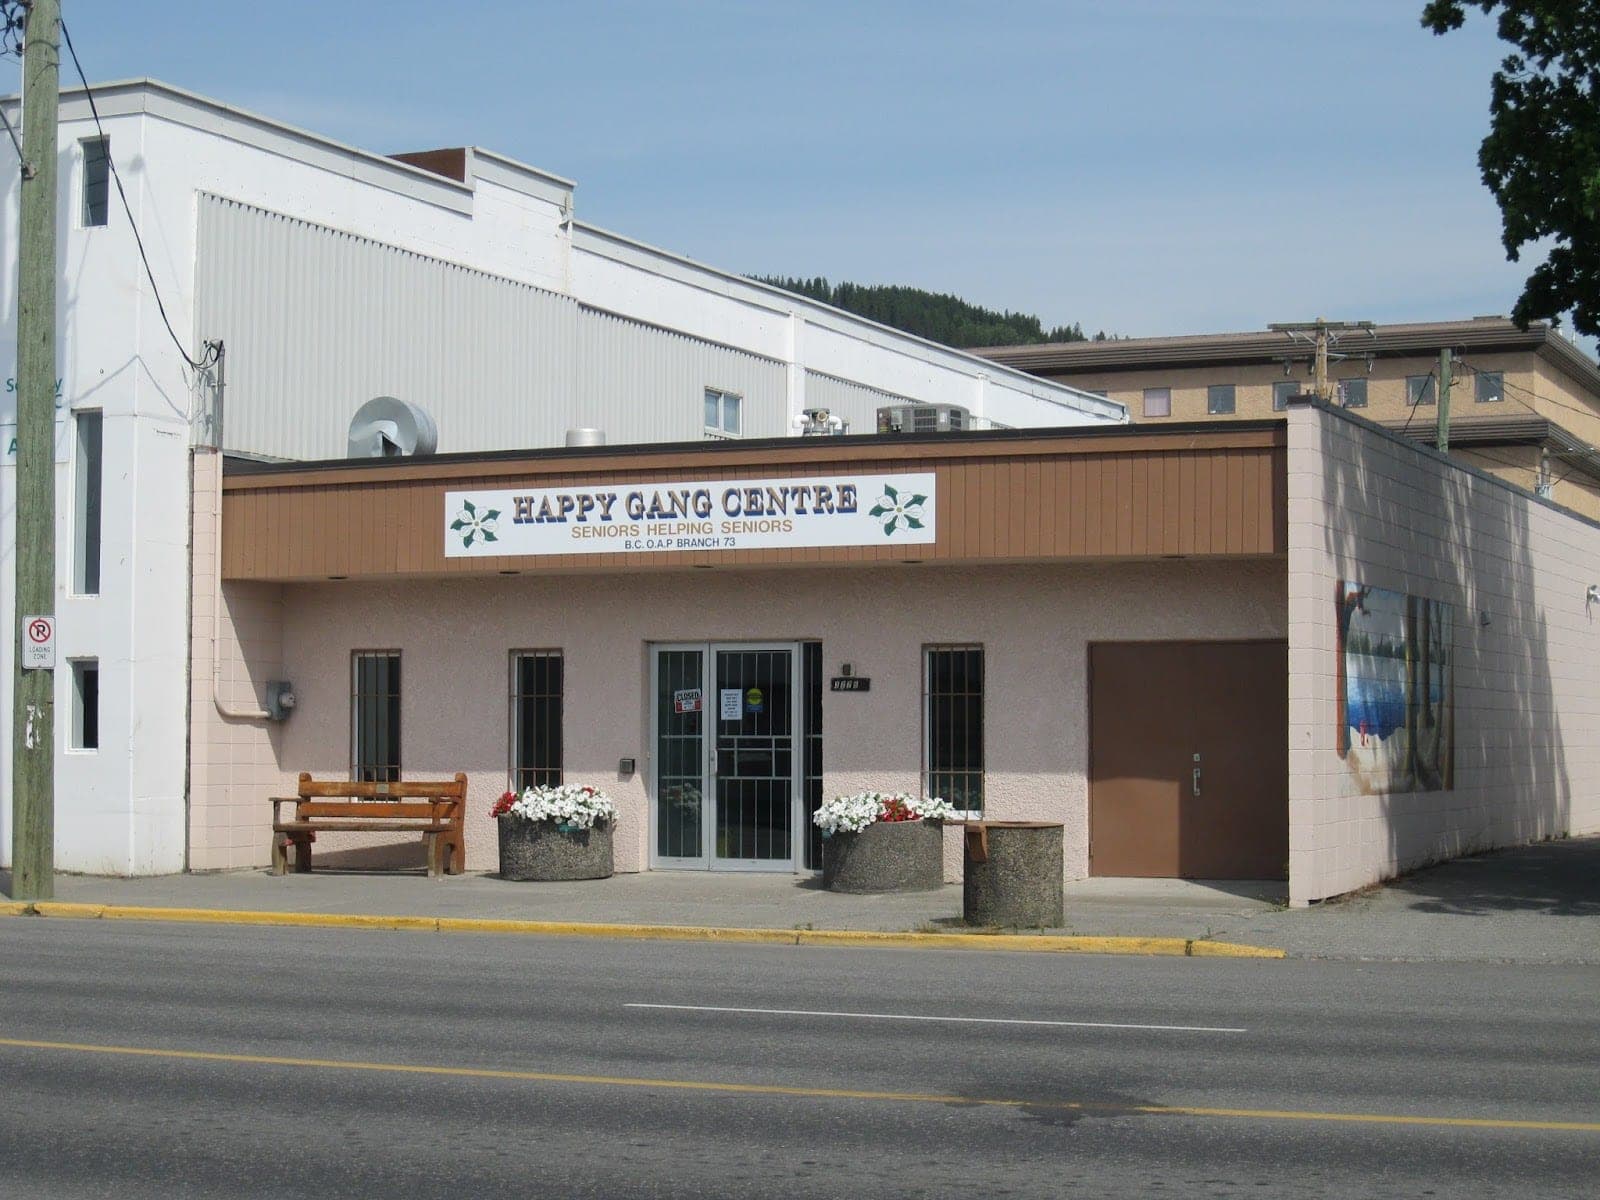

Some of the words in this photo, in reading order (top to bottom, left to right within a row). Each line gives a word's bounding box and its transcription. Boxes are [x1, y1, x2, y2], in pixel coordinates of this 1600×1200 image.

[512, 493, 617, 524] HAPPY
[625, 489, 713, 521] GANG
[721, 484, 858, 517] CENTRE
[571, 524, 640, 538] SENIORS
[647, 522, 713, 536] HELPING
[721, 520, 793, 533] SENIORS
[625, 540, 644, 549] B.C.
[677, 537, 719, 548] BRANCH
[724, 537, 736, 547] 73
[676, 692, 699, 701] CLOSED
